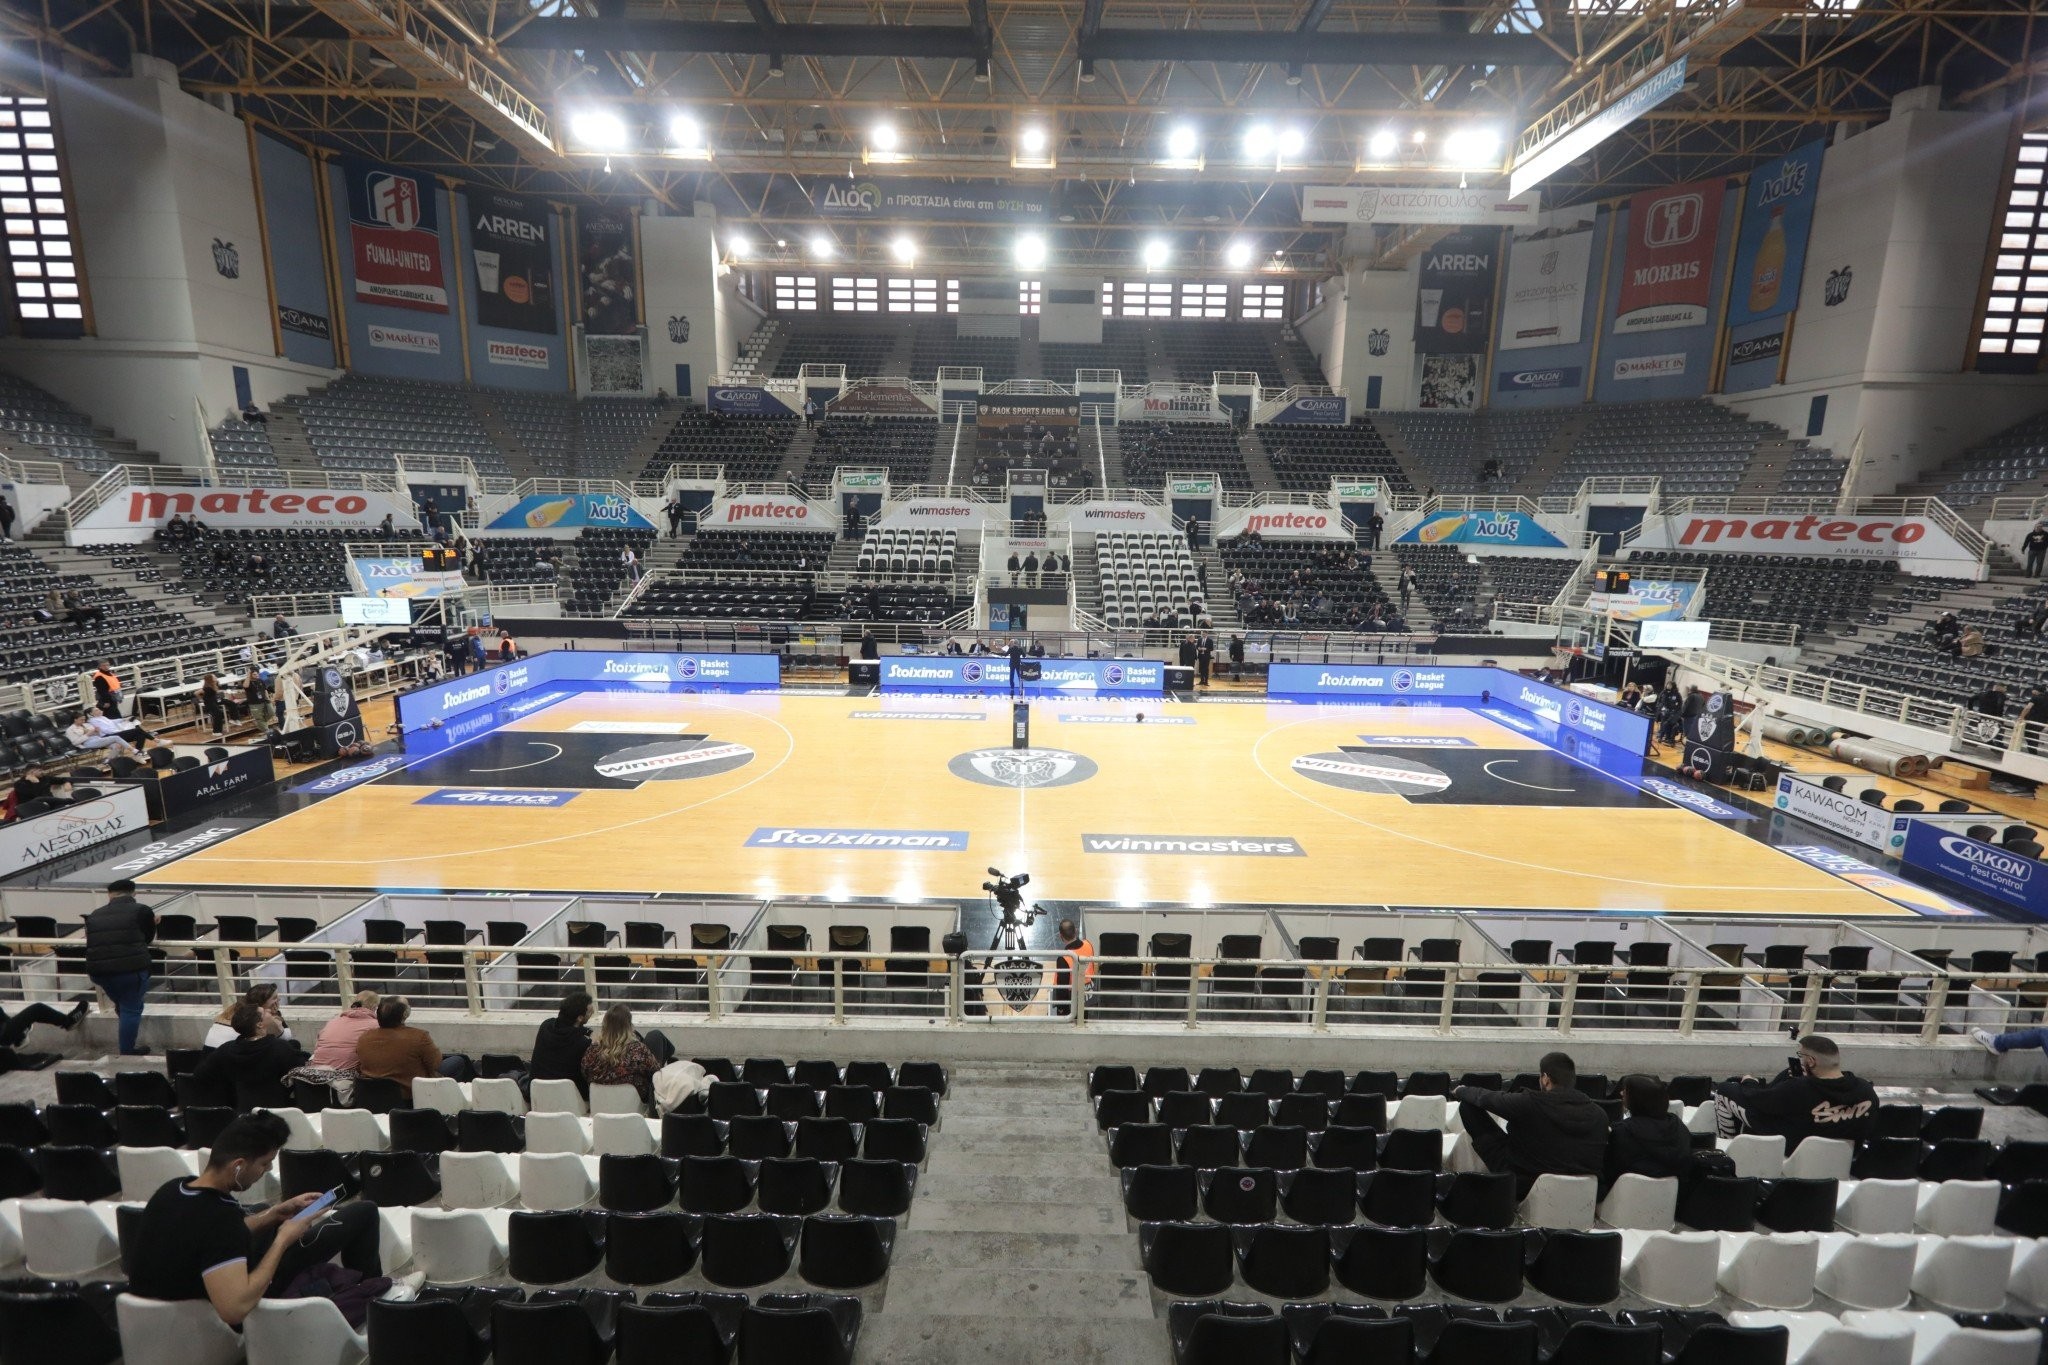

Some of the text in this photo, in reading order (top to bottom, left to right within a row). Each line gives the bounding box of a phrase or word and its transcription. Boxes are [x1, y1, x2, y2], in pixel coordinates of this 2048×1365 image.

[896, 194, 950, 208] ΠΡΟΣΤΑΣΙΑ
[953, 198, 976, 209] είναι
[978, 201, 994, 211] στη
[996, 199, 1024, 211] ΦΥΣΗ
[1026, 202, 1042, 212] του
[476, 213, 545, 241] ARREN
[365, 243, 432, 272] FUNAI-UNITED
[1427, 254, 1488, 271] ARREN
[1633, 261, 1700, 286] MORRIS
[279, 310, 328, 332] KYANA
[489, 343, 548, 360] mateco
[1733, 337, 1781, 356] KYANA
[726, 392, 760, 401] ΑΛΚΩΝ
[856, 391, 912, 402] Tselementes
[992, 407, 1011, 415] PAOK
[1012, 407, 1040, 415] SPORTS
[1144, 398, 1211, 413] Molinari
[1306, 401, 1340, 410] ΑΛΚΩΝ
[128, 488, 368, 522] mateco
[589, 500, 628, 525] λουξ
[727, 501, 808, 522] mateco
[909, 506, 971, 516] winmasters
[1085, 508, 1146, 520] winmasters
[339, 519, 367, 527] HIGH
[1247, 512, 1327, 533] mateco
[1475, 516, 1519, 541] λουξ
[1679, 515, 1926, 546] mateco
[1008, 539, 1048, 547] winmasters
[1835, 547, 1919, 557] AIMING HIGH
[603, 660, 669, 674] Stoiximan
[700, 659, 730, 669] Basket
[888, 664, 954, 679] Stoiximan
[985, 664, 1010, 673] Baske
[1126, 667, 1156, 677] Basket
[508, 666, 527, 680] Basket
[509, 674, 528, 688] League
[700, 668, 730, 678] League
[1126, 675, 1156, 685] League
[1317, 672, 1384, 687] Stoiximan
[1415, 673, 1445, 682] Basket
[1415, 681, 1444, 690] League
[442, 684, 491, 710] Stoiximan
[1520, 686, 1562, 715] Stoiximan
[854, 711, 982, 720] winmasters
[1583, 706, 1607, 722] Basket
[1583, 717, 1605, 732] League
[601, 744, 748, 775] winmasters
[1295, 756, 1450, 787] winmasters
[196, 783, 221, 797] ARAL
[224, 773, 248, 789] FARM
[1794, 785, 1868, 822] KAWACOM
[57, 818, 89, 833] ΝΙΚΟΣ
[1842, 814, 1866, 828] NORTH
[22, 814, 127, 863] ΑΛΕΞΟΥΔΑΣ
[759, 827, 950, 848] Stoiximan
[112, 827, 240, 871] SPALDING
[1090, 837, 1295, 855] winmasters
[1959, 842, 2025, 877] ΑΛΚΩΝ
[1970, 864, 2024, 892] Pest Control
